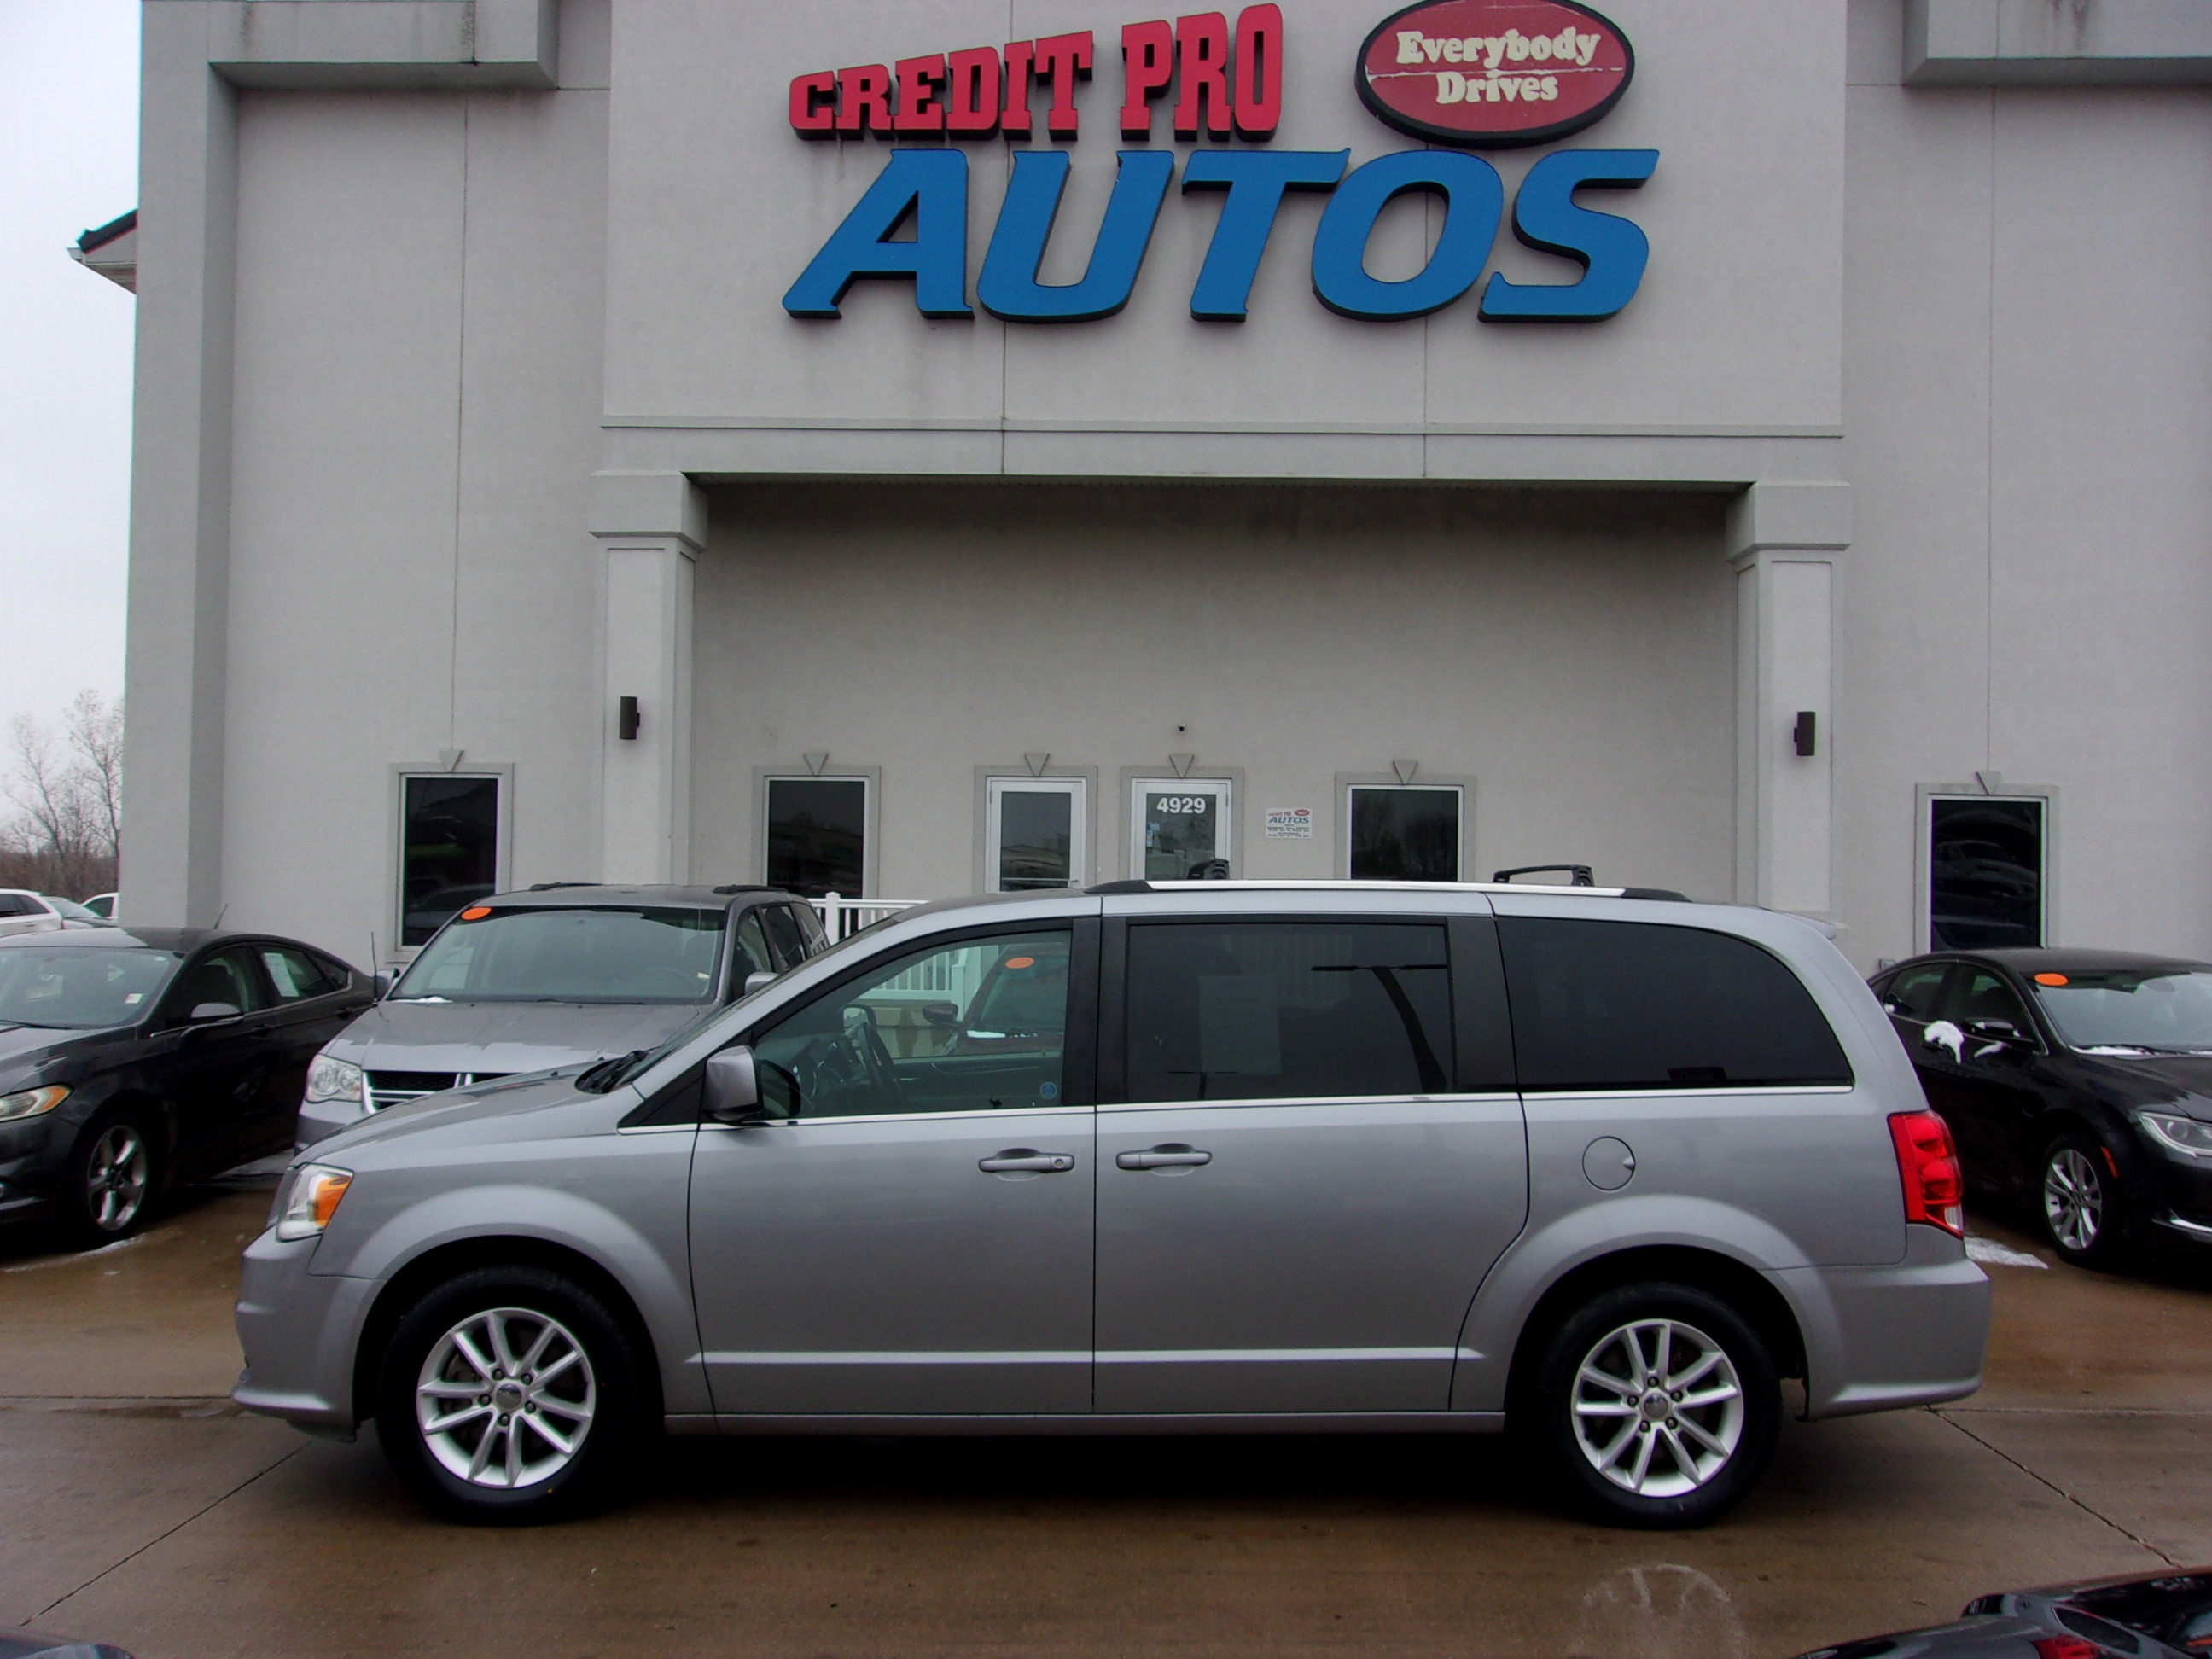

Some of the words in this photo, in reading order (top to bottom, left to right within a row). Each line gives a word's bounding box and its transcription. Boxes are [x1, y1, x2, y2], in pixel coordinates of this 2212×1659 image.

[1396, 26, 1601, 69] Everybody
[789, 30, 1094, 137] CREDIT
[1120, 3, 1284, 137] PRO
[1435, 71, 1559, 104] Drives
[782, 148, 1661, 321] AUTOS
[1156, 797, 1207, 814] 4929
